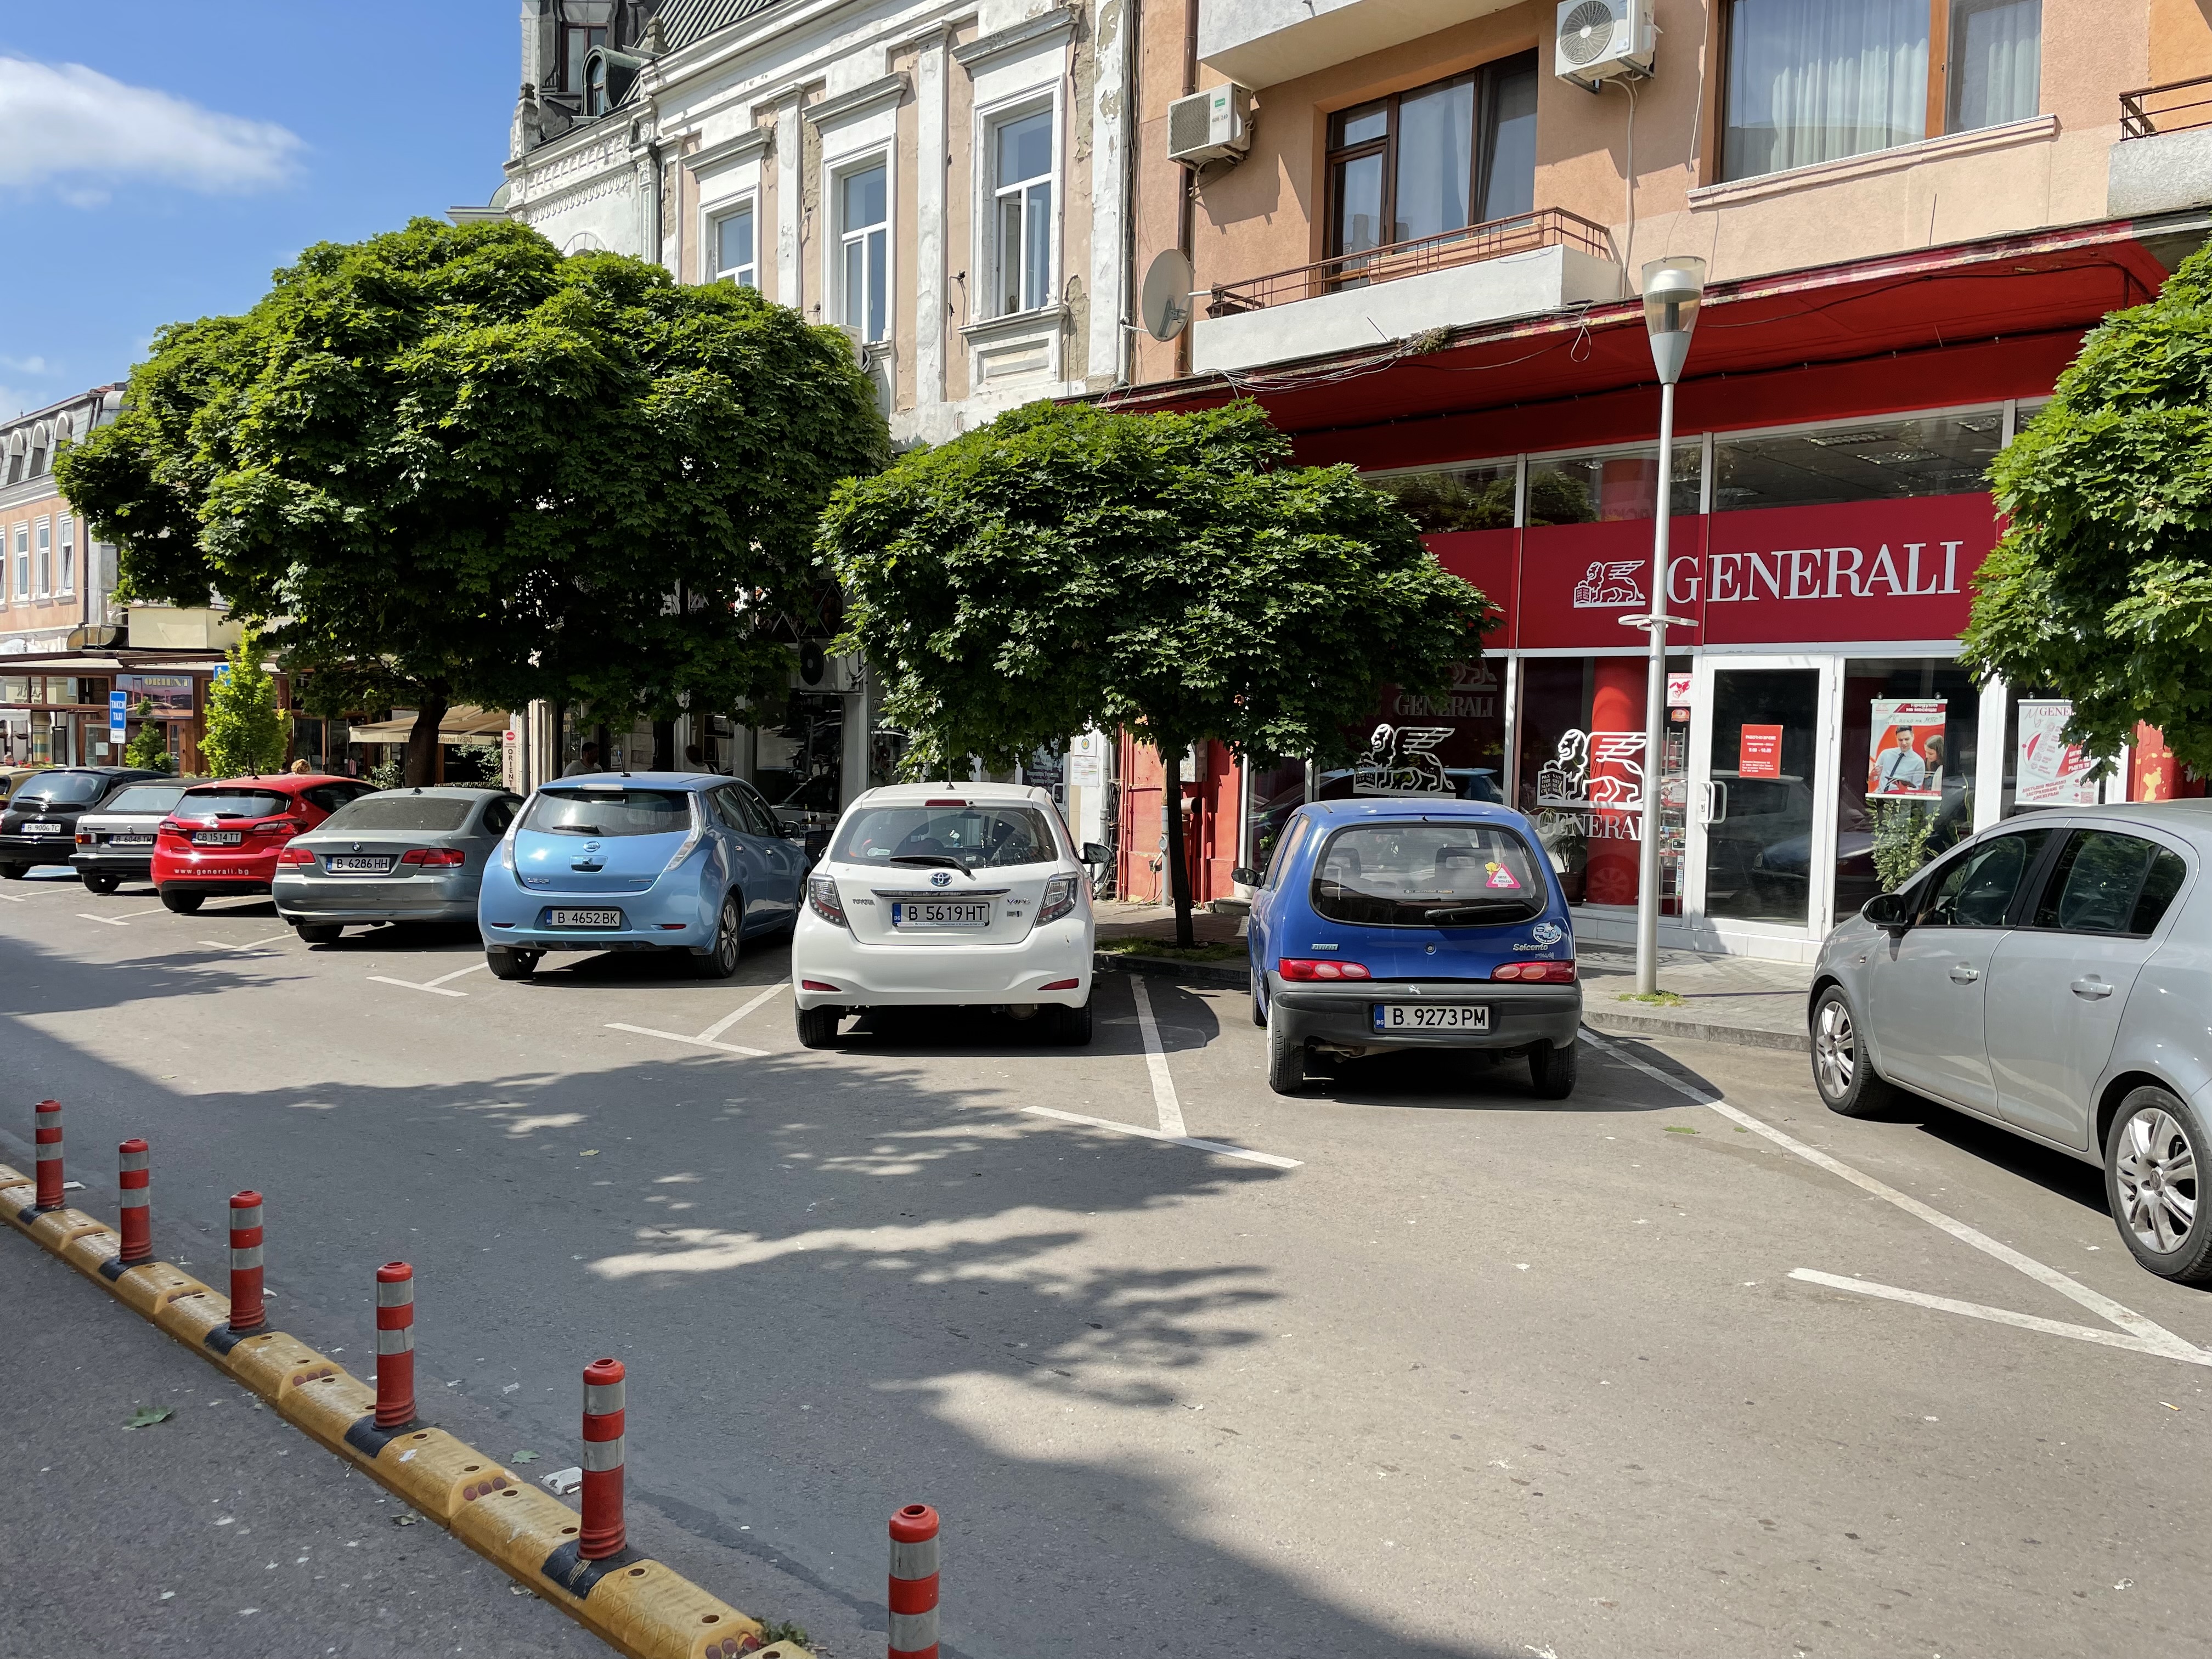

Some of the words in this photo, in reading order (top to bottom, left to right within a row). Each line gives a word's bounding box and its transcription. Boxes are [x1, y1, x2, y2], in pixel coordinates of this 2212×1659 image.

[1667, 541, 1963, 604] GENERALI
[144, 678, 188, 686] ORIENT
[111, 700, 125, 709] ТАКСИ
[113, 712, 123, 720] TAXI
[2040, 707, 2074, 716] GENE
[1537, 811, 1643, 841] GENERA
[337, 859, 343, 868] B
[348, 859, 372, 868] 6286
[374, 859, 388, 868] HH
[558, 912, 565, 923] B
[572, 912, 600, 924] 4652
[602, 913, 617, 924] BK
[909, 906, 918, 921] B
[926, 906, 963, 921] 5619
[967, 906, 985, 921] HT
[1513, 943, 1548, 951] Seicento
[1393, 1008, 1404, 1025] B
[1414, 1008, 1458, 1026] 9273
[1462, 1009, 1486, 1026] PM
